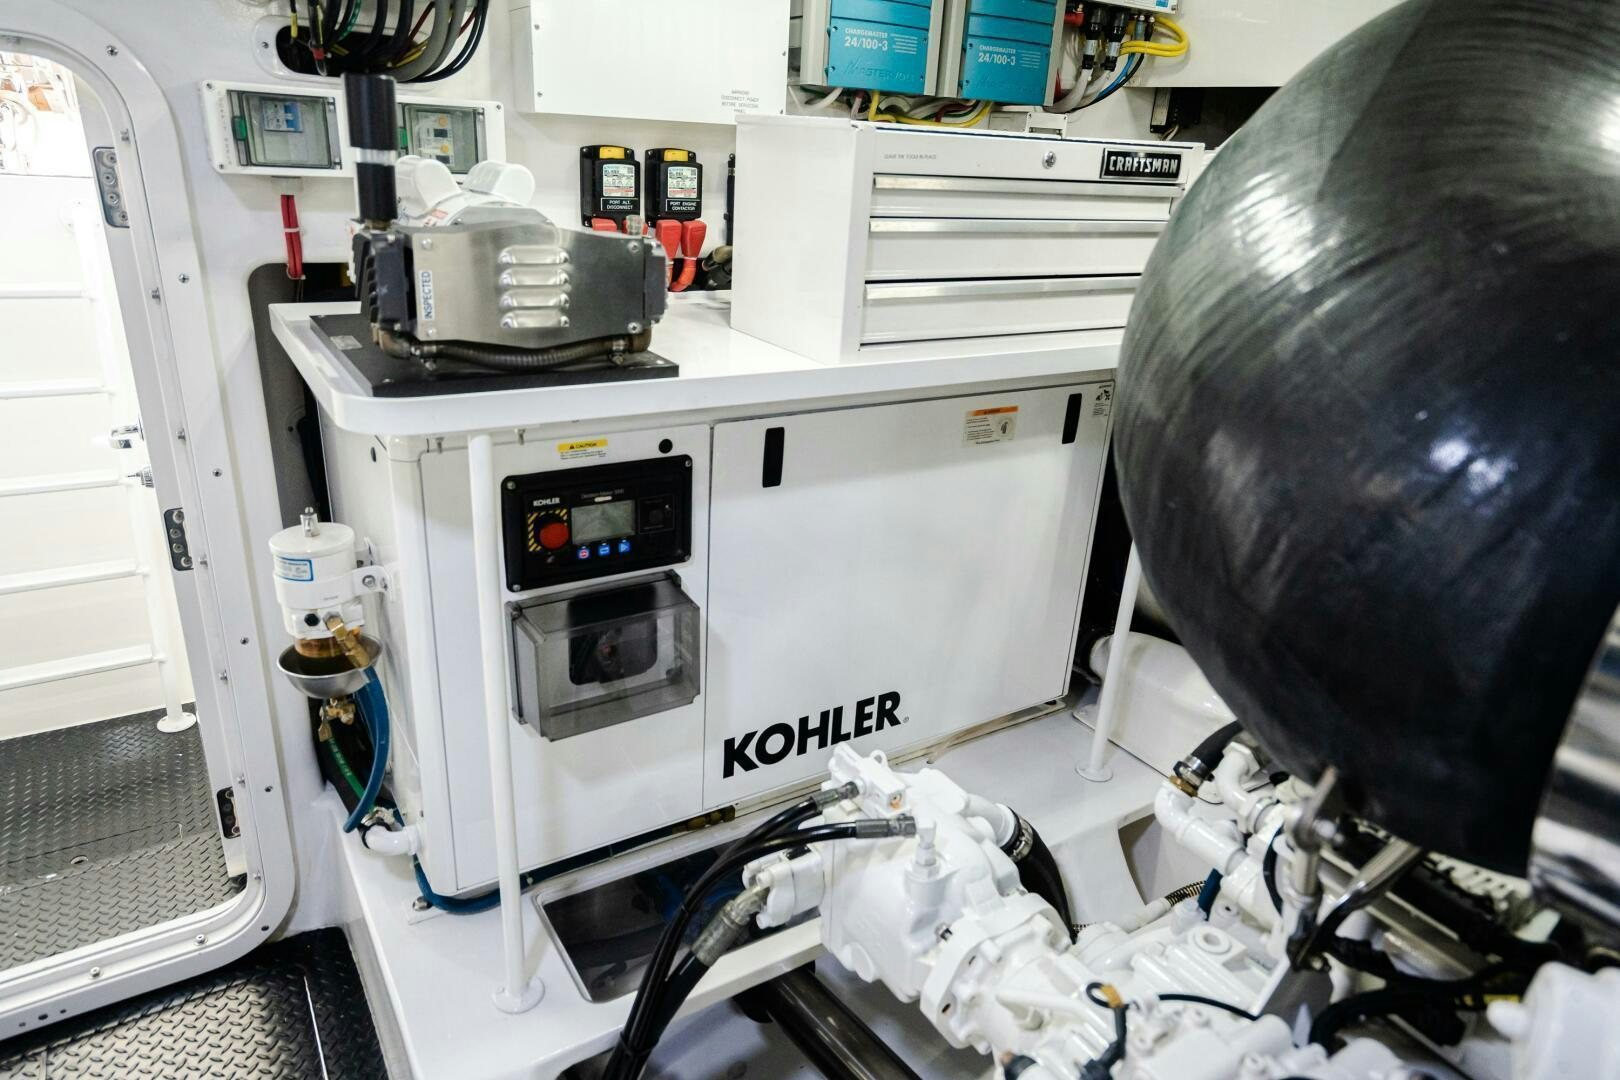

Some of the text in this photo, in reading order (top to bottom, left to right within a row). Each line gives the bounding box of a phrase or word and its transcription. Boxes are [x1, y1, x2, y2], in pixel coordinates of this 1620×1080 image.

[844, 27, 888, 38] CHARGEMASTER
[844, 37, 888, 51] 24/100-3
[979, 45, 1016, 54] CHARGEMASTER
[978, 52, 1016, 65] 24/100-3
[1109, 156, 1178, 173] CRAFTSMAN
[533, 497, 561, 507] KOHLER
[723, 691, 901, 779] KOHLER
